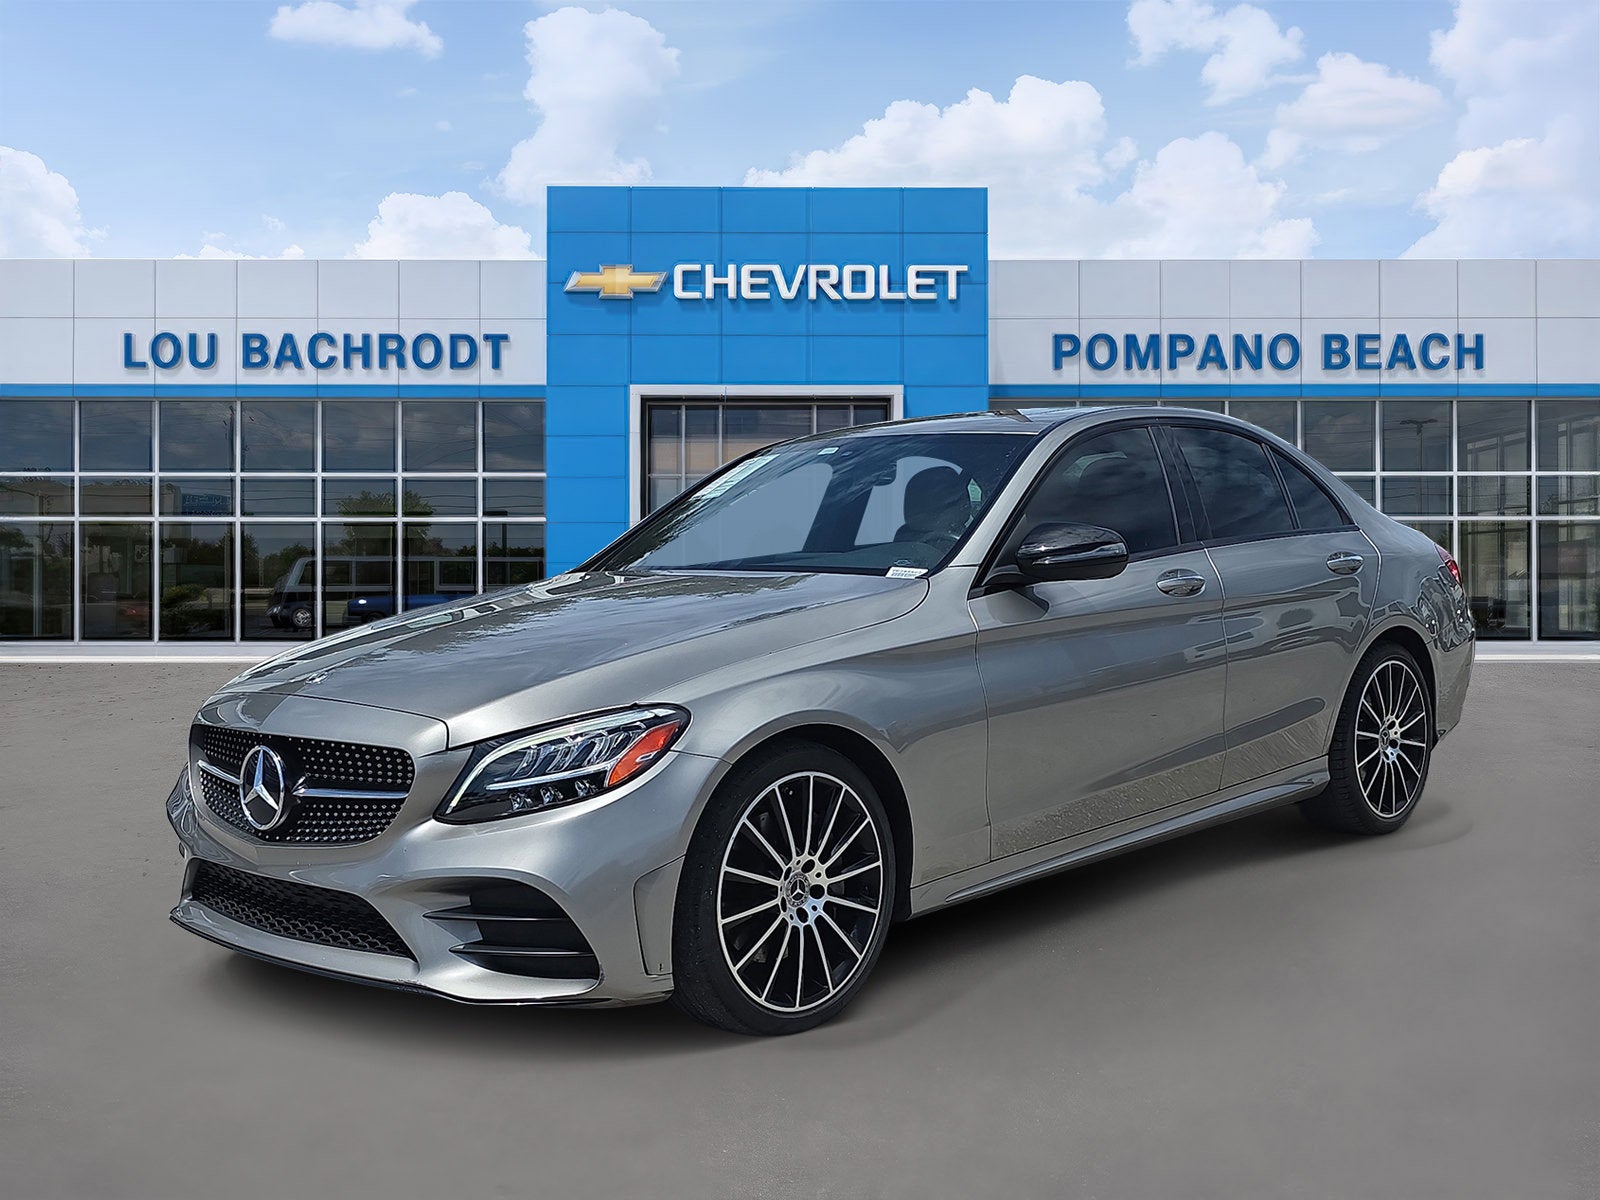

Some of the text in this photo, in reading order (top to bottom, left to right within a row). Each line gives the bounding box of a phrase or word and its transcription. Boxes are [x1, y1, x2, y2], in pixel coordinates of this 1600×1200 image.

[673, 263, 969, 301] CHEVROLET
[123, 332, 510, 370] LOU BACHRODT
[1052, 332, 1485, 371] POMPANO BEACH
